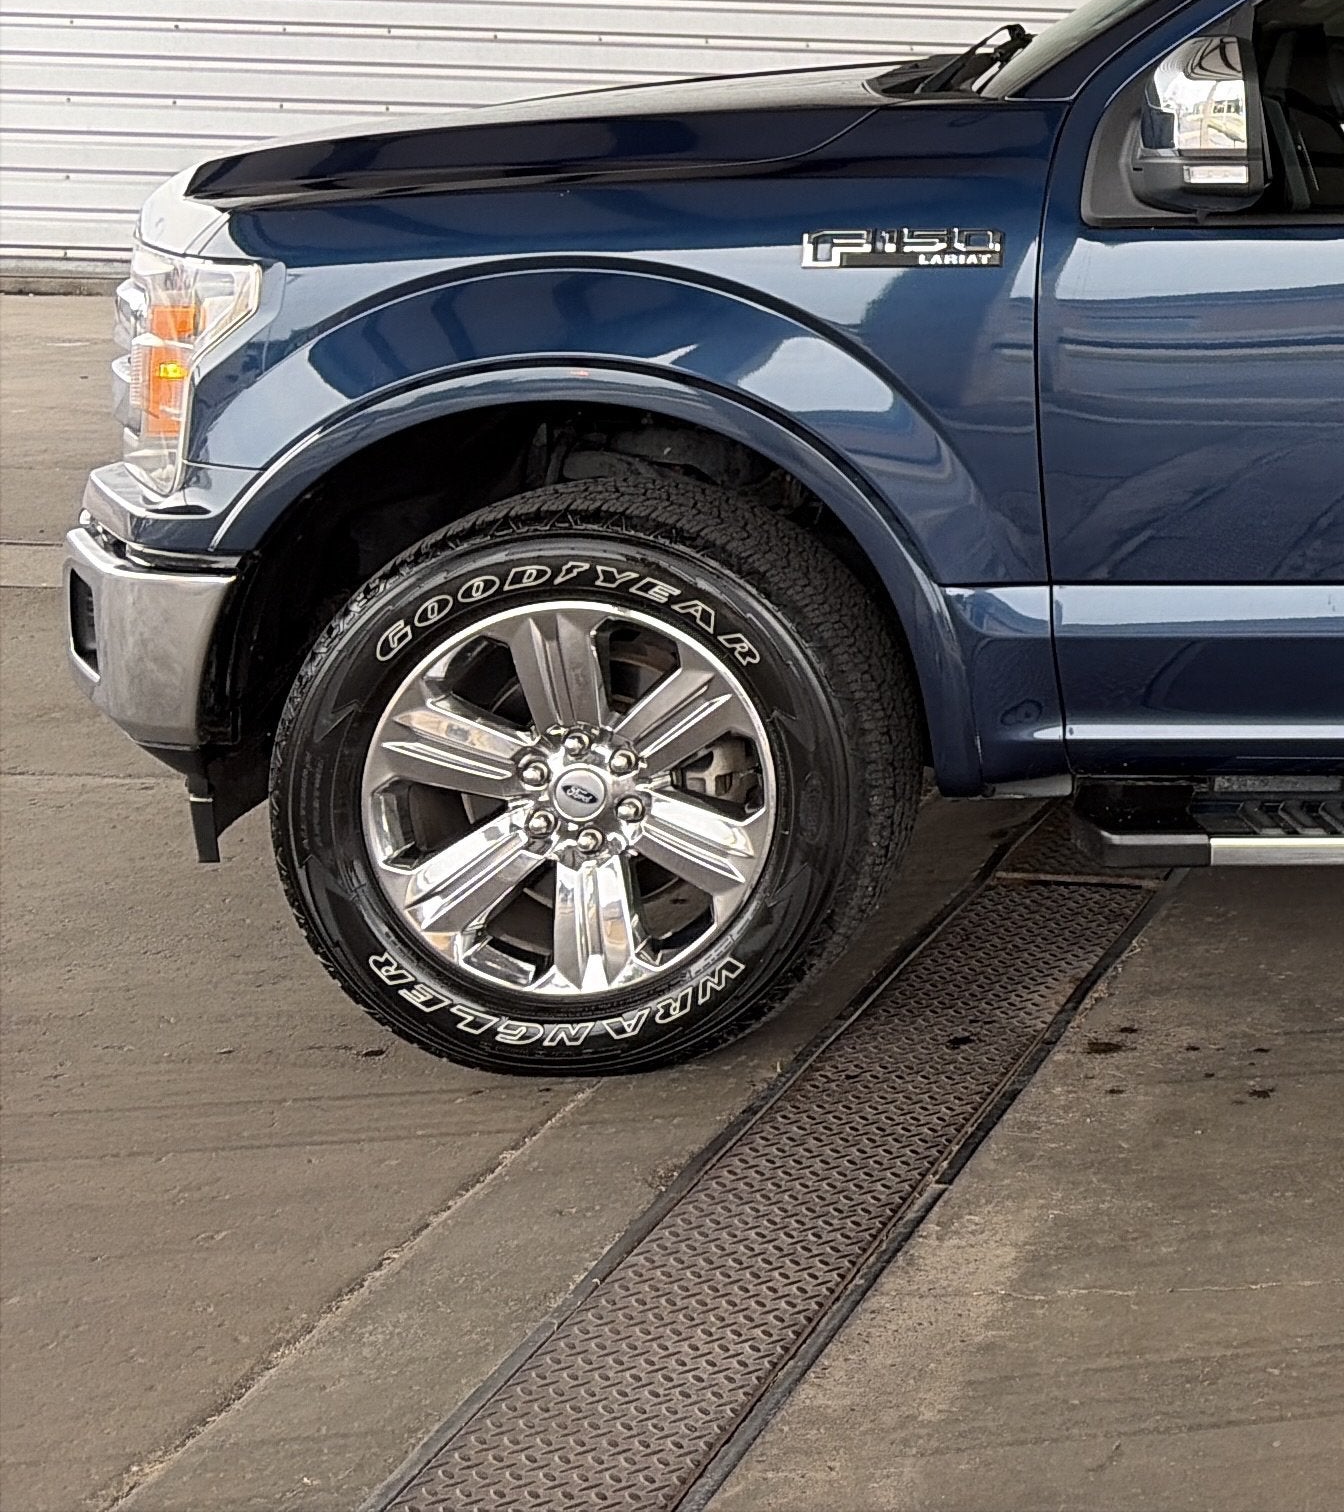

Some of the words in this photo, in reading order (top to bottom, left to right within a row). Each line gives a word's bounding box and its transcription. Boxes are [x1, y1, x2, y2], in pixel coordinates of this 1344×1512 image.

[918, 253, 992, 265] LARIAT
[375, 561, 761, 666] GOODYEAR
[564, 786, 595, 803] Ford
[368, 950, 746, 1047] WRANGLER
